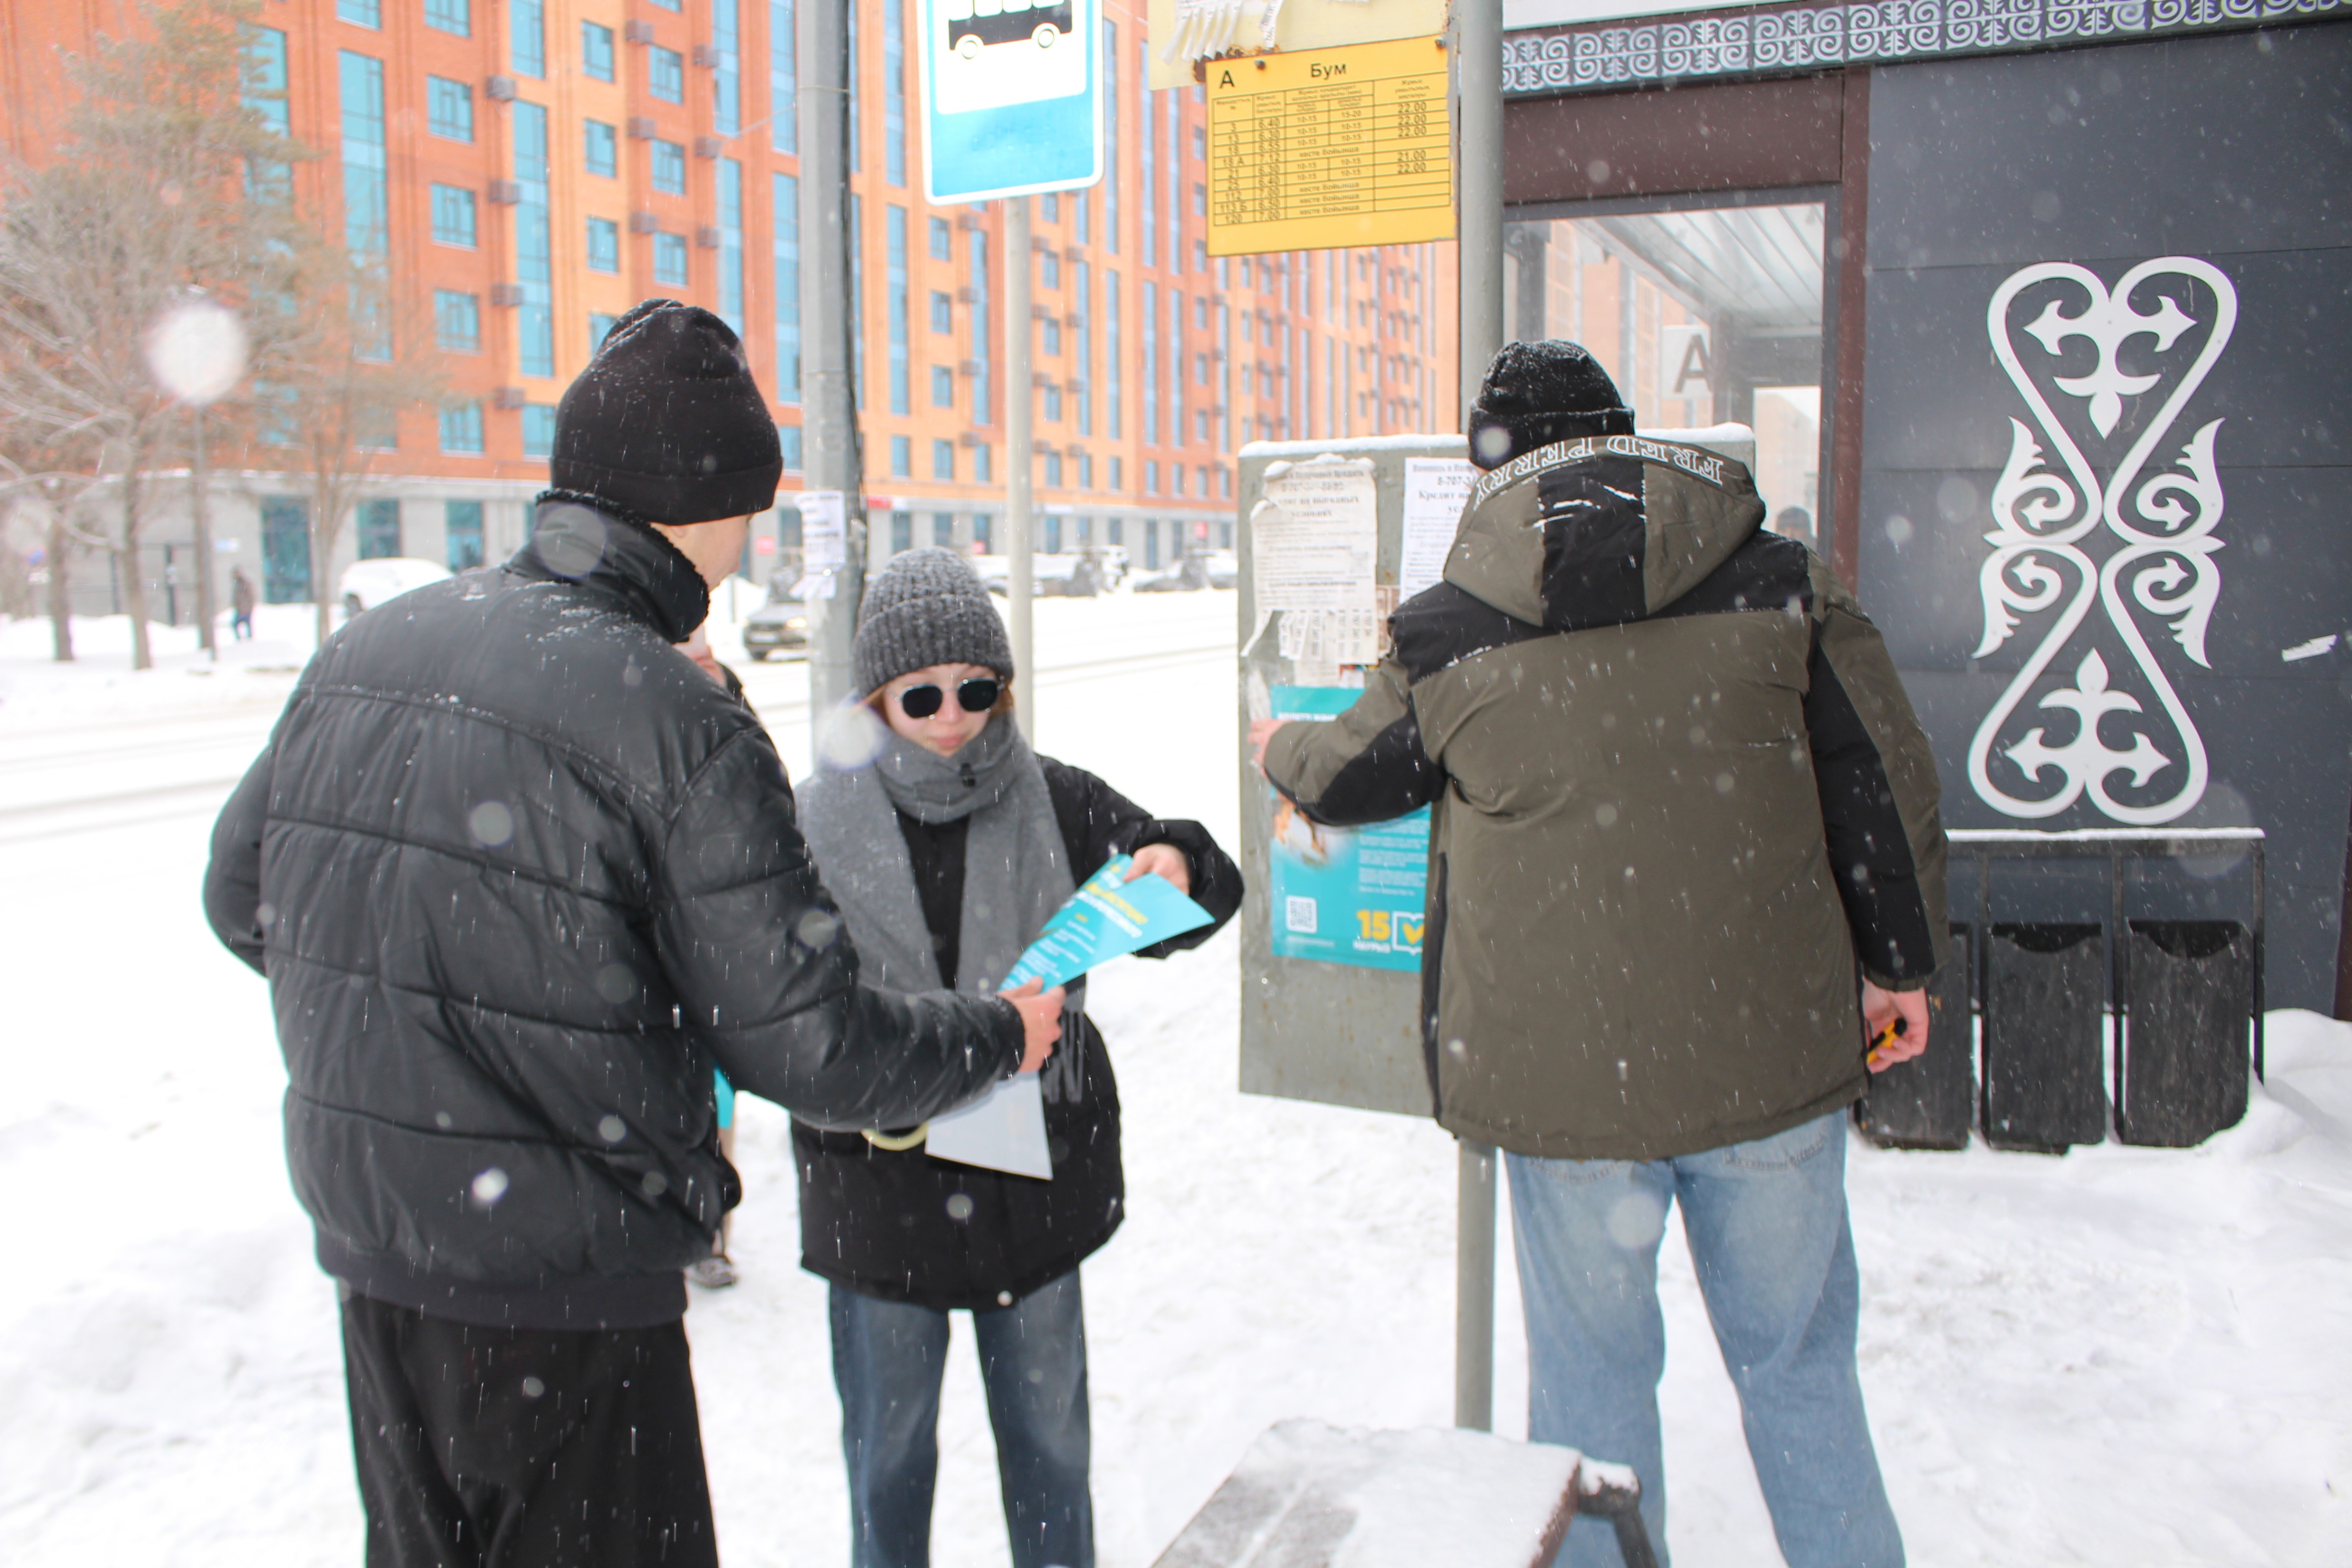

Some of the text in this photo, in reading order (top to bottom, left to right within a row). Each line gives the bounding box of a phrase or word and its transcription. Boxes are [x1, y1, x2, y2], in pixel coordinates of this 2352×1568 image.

[1310, 62, 1347, 80] Бум
[1398, 102, 1427, 114] 22.00
[1398, 114, 1427, 126] 22.00
[1398, 126, 1427, 138] 22.00
[1398, 149, 1427, 162] 21.00
[1398, 162, 1427, 175] 22.00
[1473, 435, 1723, 510] FRED PERRY
[1356, 909, 1391, 941] 15
